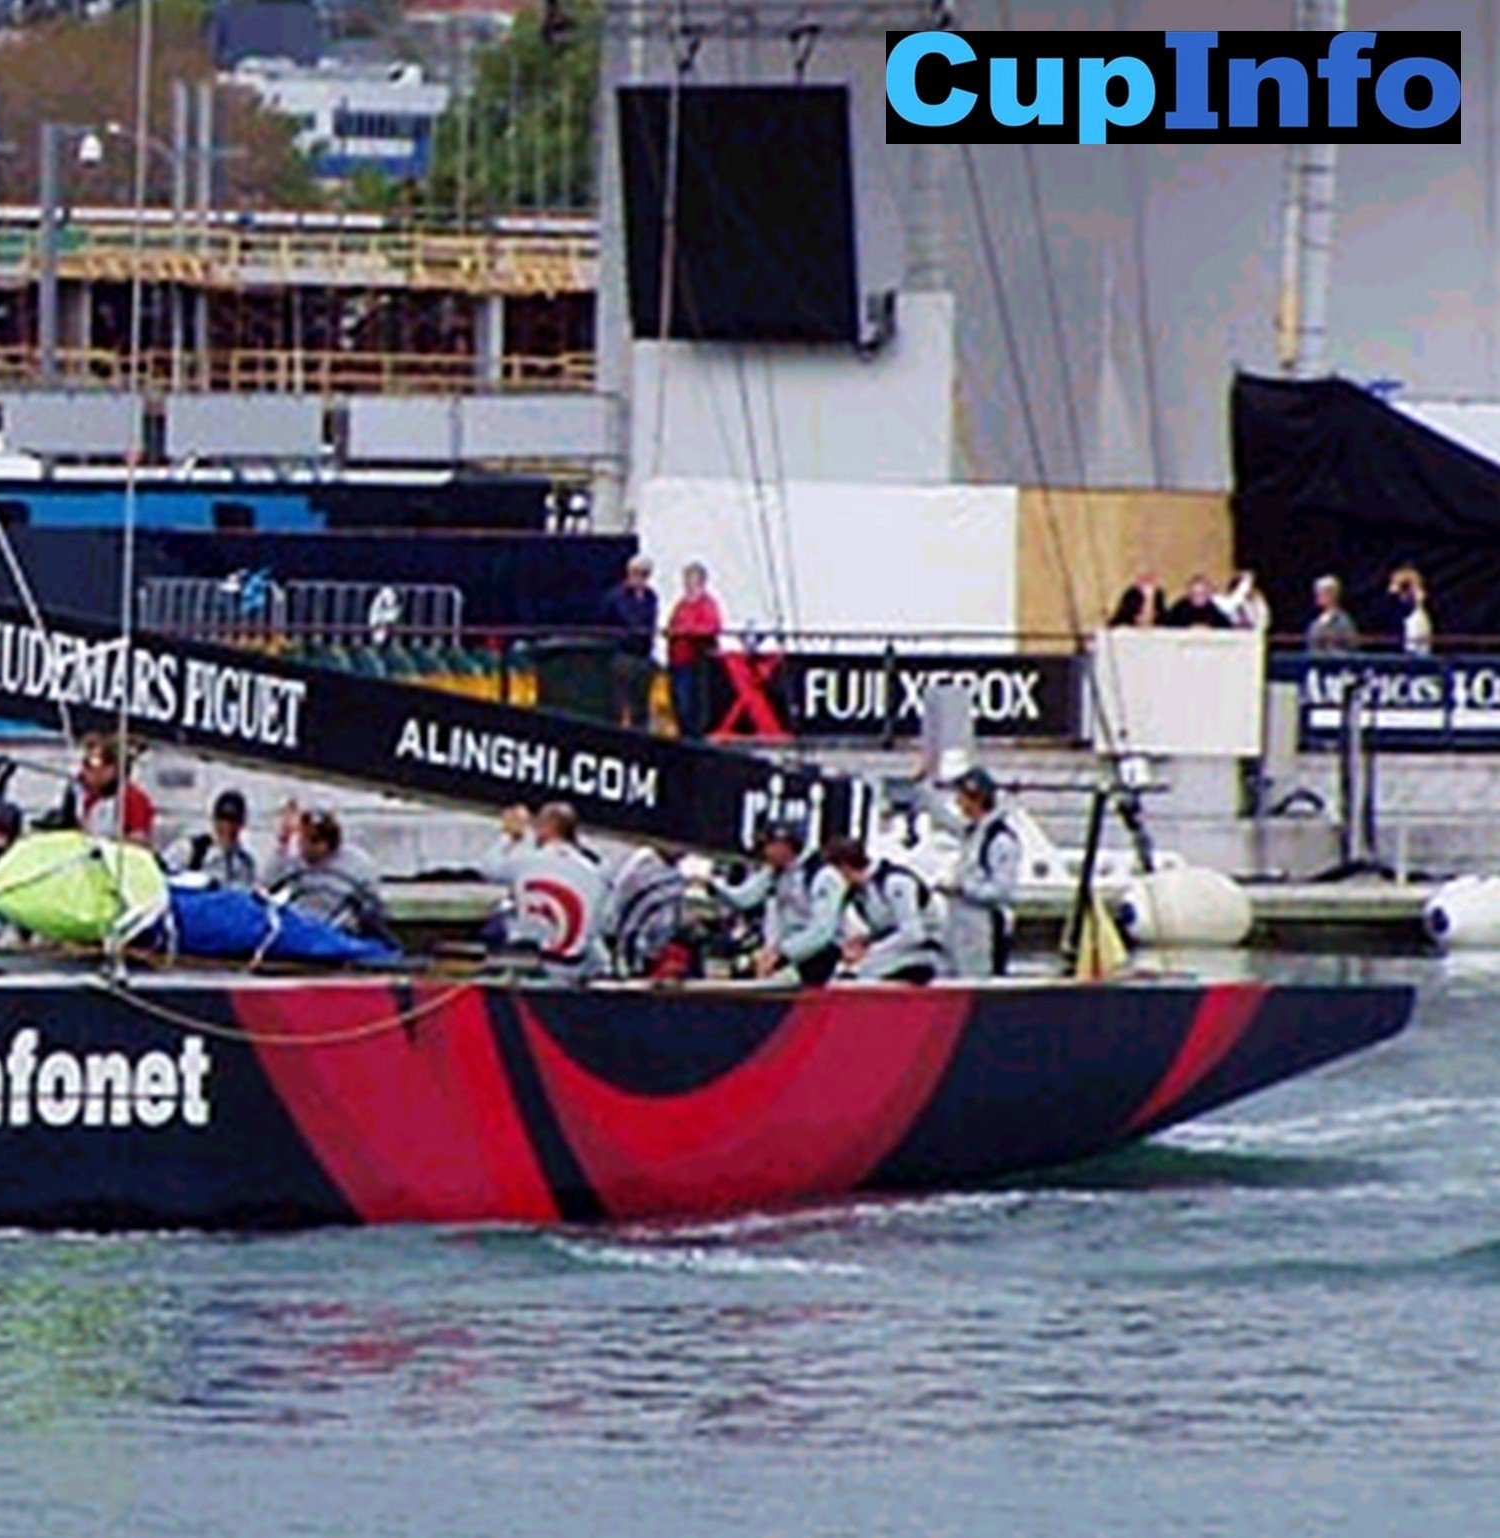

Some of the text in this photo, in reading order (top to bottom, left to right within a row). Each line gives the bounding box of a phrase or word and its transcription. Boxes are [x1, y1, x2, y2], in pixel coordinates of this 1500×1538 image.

[182, 659, 306, 748] PIGUET
[805, 668, 887, 719] FUJI
[396, 718, 657, 807] ALINGHI.COM
